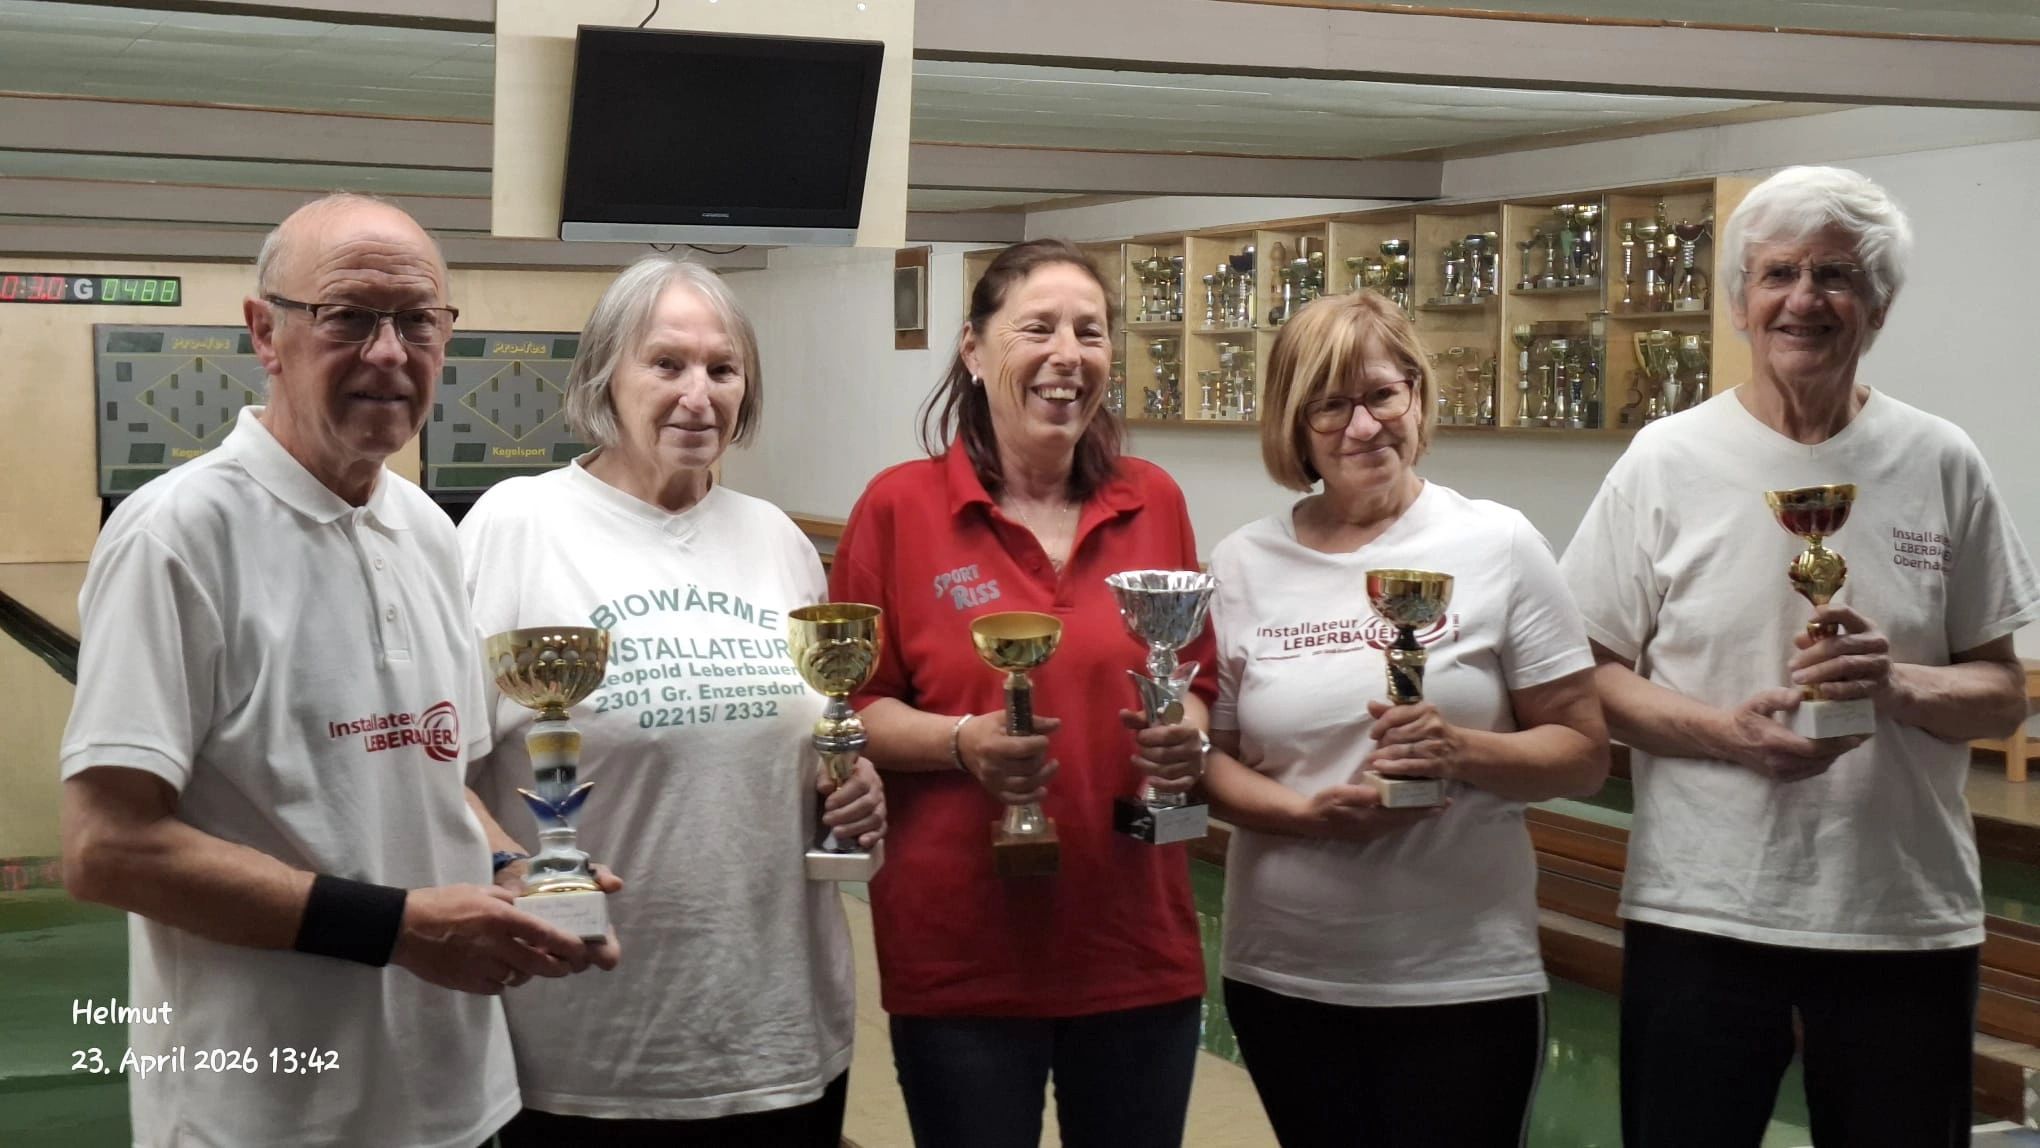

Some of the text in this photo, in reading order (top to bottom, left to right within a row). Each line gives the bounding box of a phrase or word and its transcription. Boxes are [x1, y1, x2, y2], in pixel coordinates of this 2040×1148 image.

[73, 278, 94, 300] G
[102, 278, 177, 302] 0488
[491, 446, 546, 459] Kegelsport
[934, 564, 980, 600] SPORT
[950, 579, 1002, 611] RISS
[588, 584, 779, 631] BIOWÄRME
[1256, 618, 1359, 639] Installateur
[607, 637, 793, 666] NSTALLATEUR
[599, 662, 681, 688] eopold
[595, 680, 805, 714] 2301 Gr. Enzersdorf
[725, 699, 778, 721] 2332
